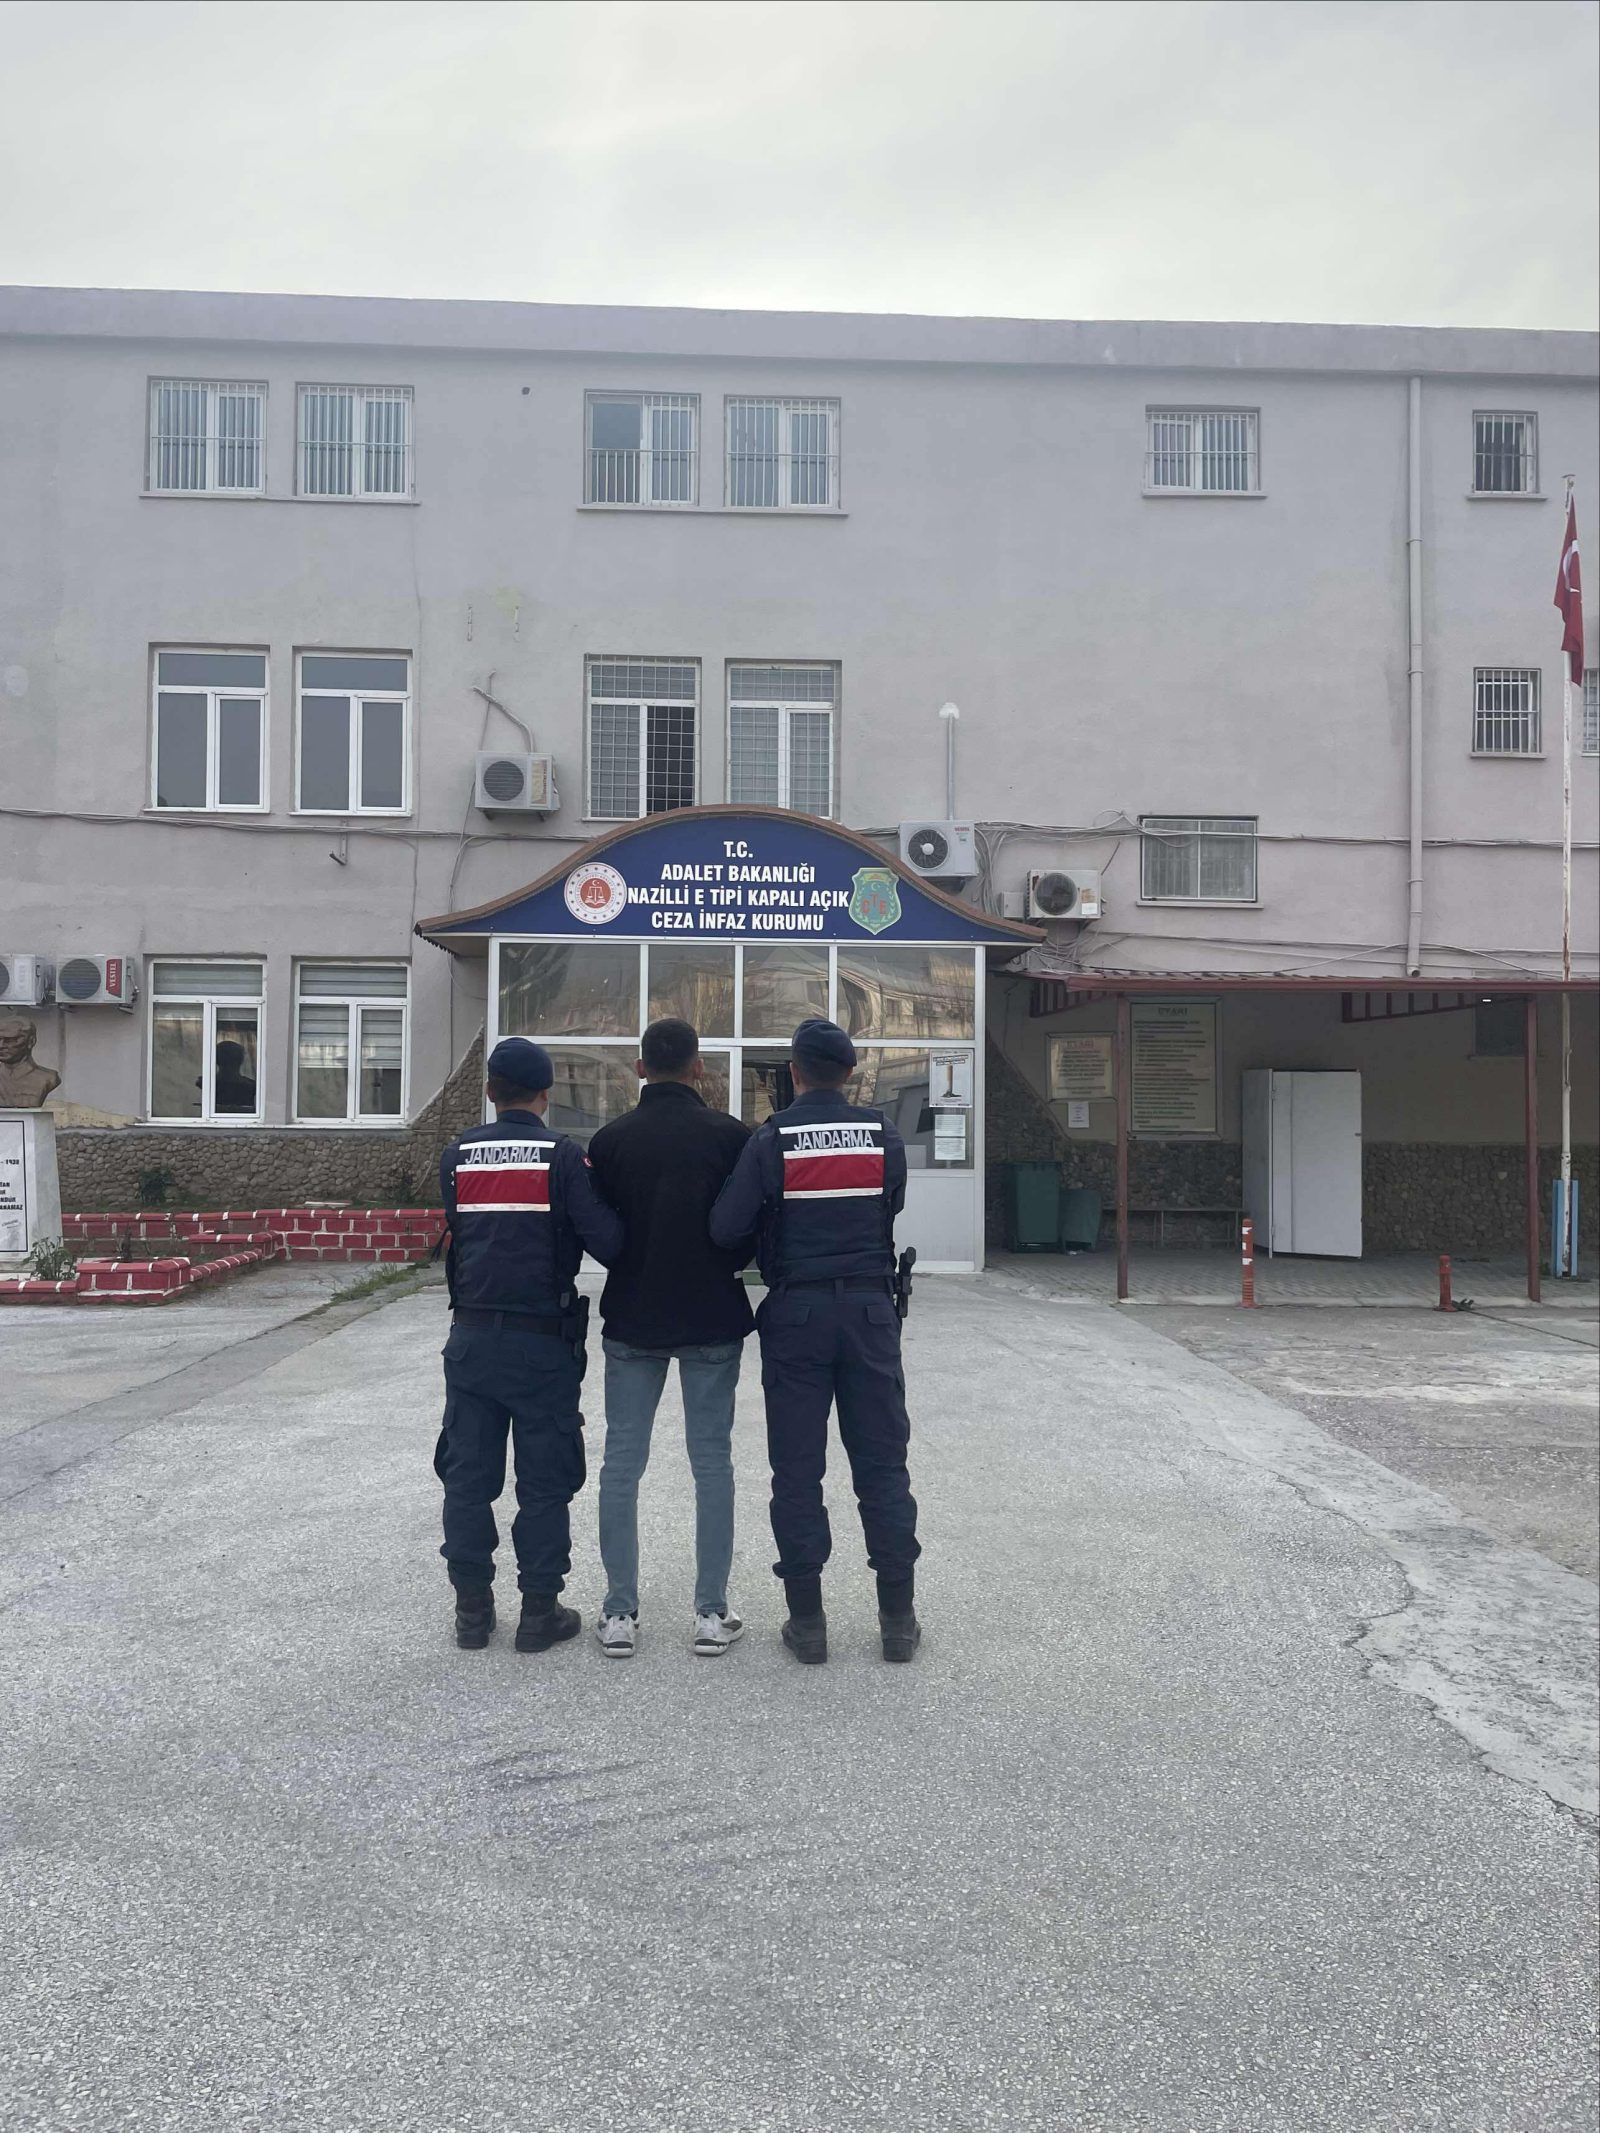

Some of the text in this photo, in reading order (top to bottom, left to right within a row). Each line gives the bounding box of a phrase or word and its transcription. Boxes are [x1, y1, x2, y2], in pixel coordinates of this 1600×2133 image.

[723, 841, 753, 858] T.C.
[661, 863, 815, 883] ADALET BAKANLIĞI
[628, 884, 689, 905] NAZİLLİ
[695, 888, 704, 905] E
[710, 885, 742, 906] TİPİ
[748, 889, 804, 907] KAPALI
[809, 890, 849, 911] AÇIK
[651, 908, 824, 931] CEZA İNFAZ KURUMU
[109, 963, 117, 988] VESTEL
[794, 1130, 874, 1151] JANDARMA
[465, 1147, 540, 1164] JANDARMA
